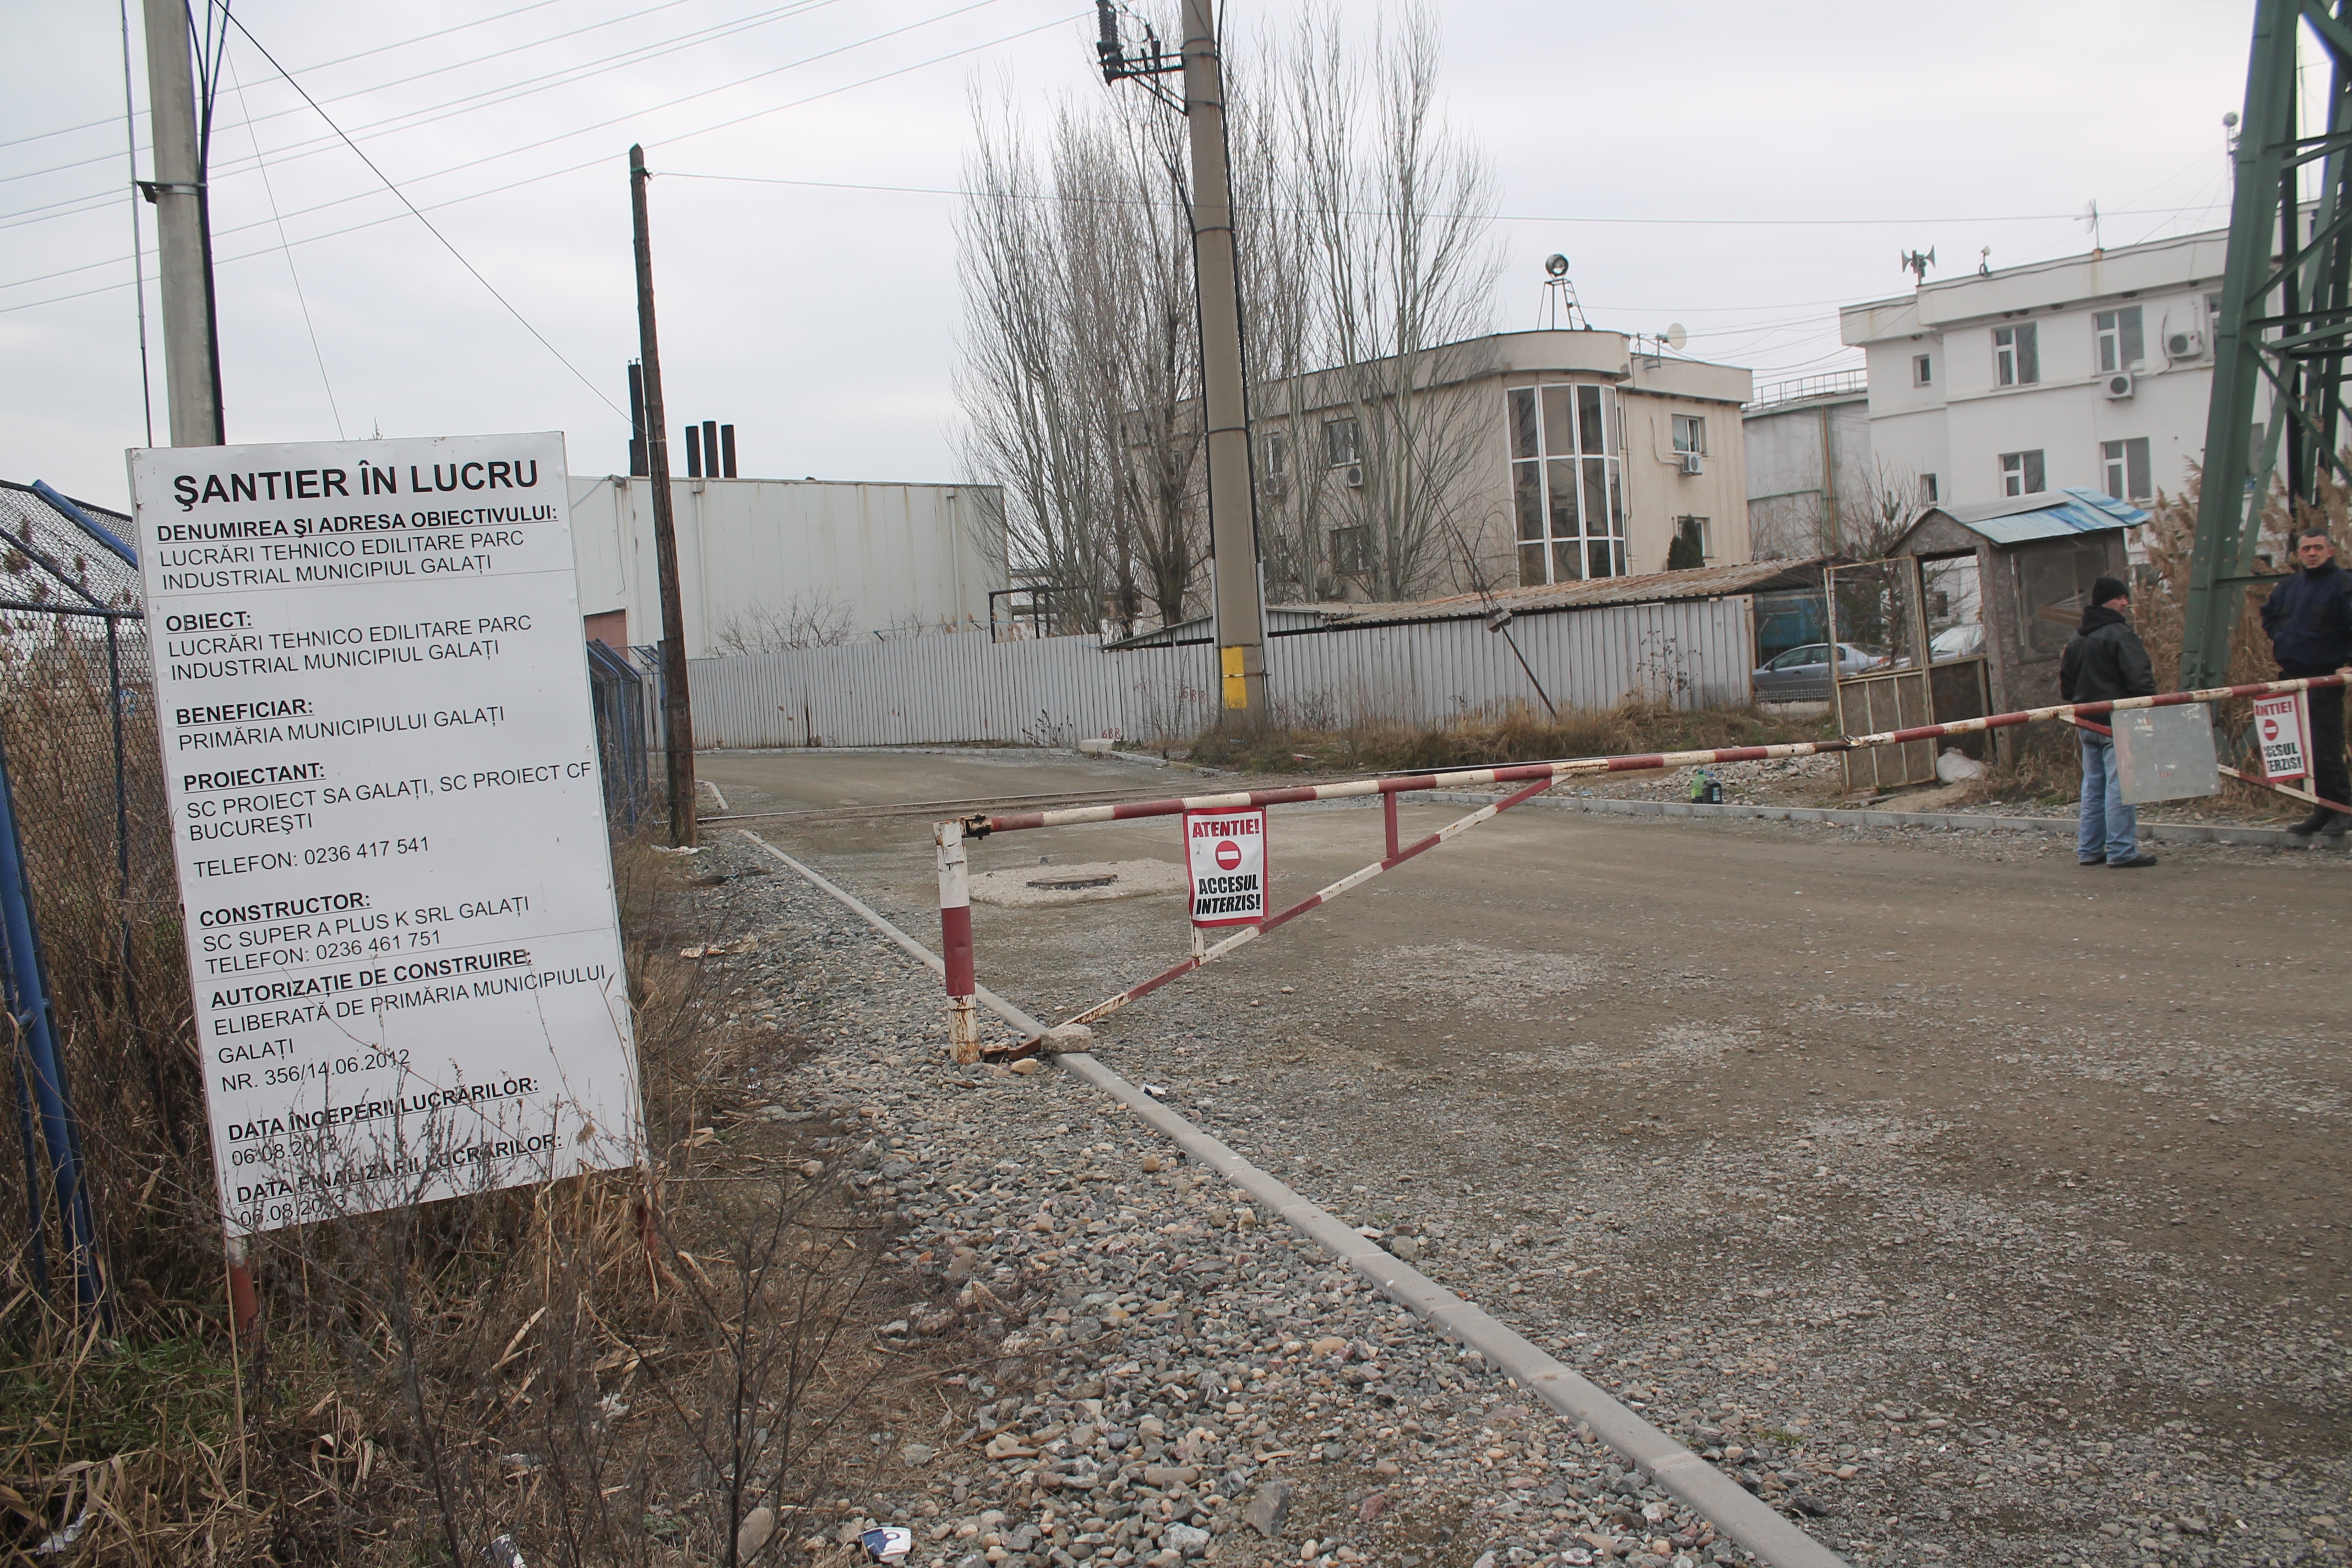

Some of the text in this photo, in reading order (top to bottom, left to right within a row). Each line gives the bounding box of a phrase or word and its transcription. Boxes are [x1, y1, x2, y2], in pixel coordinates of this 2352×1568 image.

[358, 460, 397, 496] ÎN
[411, 460, 537, 493] LUCRU
[157, 520, 289, 541] DENUMIREA
[319, 513, 406, 533] ADRESA
[411, 505, 557, 527] OBIECTIVULUI:
[160, 530, 524, 567] LUCRĂRI TEHNICO EDILITARE PARC
[163, 568, 291, 590] INDUSTRIAL
[296, 560, 416, 582] MUNICIPIUL
[166, 611, 252, 631] OBIECT:
[168, 615, 531, 657] LUCRĂRI TEHNICO EDILITARE PARC
[171, 656, 299, 681] INDUSTRIAL
[304, 646, 423, 670] MUNICIPIUL
[176, 699, 313, 725] BENEFICIAR:
[179, 726, 284, 751] PRIMĂRIA
[287, 713, 427, 741] MUNICIPIULUI
[183, 762, 324, 791] PROIECTANT:
[187, 801, 216, 819] SC
[223, 790, 316, 815] PROIECT
[323, 787, 352, 804] SA
[440, 775, 467, 792] SC
[473, 765, 560, 788] PROIECT
[567, 761, 591, 778] CF
[1193, 819, 1259, 838] ATENTIE!
[193, 836, 428, 878] TELEFON: 0236 417 541
[1199, 874, 1258, 895] ACCESUL
[200, 892, 370, 927] CONSTRUCTOR:
[1196, 894, 1261, 914] INTERZIS!
[203, 934, 232, 952] SC
[239, 923, 312, 948] SUPER
[317, 922, 331, 938] A
[335, 913, 389, 935] PLUS
[395, 911, 409, 927] K
[415, 906, 454, 924] SRL
[205, 929, 439, 974] TELEFON: 0236 461 751
[361, 968, 388, 987] DE
[394, 949, 531, 981] CONSTRUIRE:
[214, 964, 605, 1036] ELIBERATĂ DE PRIMĂRIA MUNICIPIULUI
[222, 1049, 411, 1092] NR. 356/14.06.2012
[227, 1117, 285, 1140] DATA
[231, 1135, 337, 1166] 06.08.202
[236, 1178, 293, 1202] DATA
[239, 1194, 346, 1227] 06.08.203
